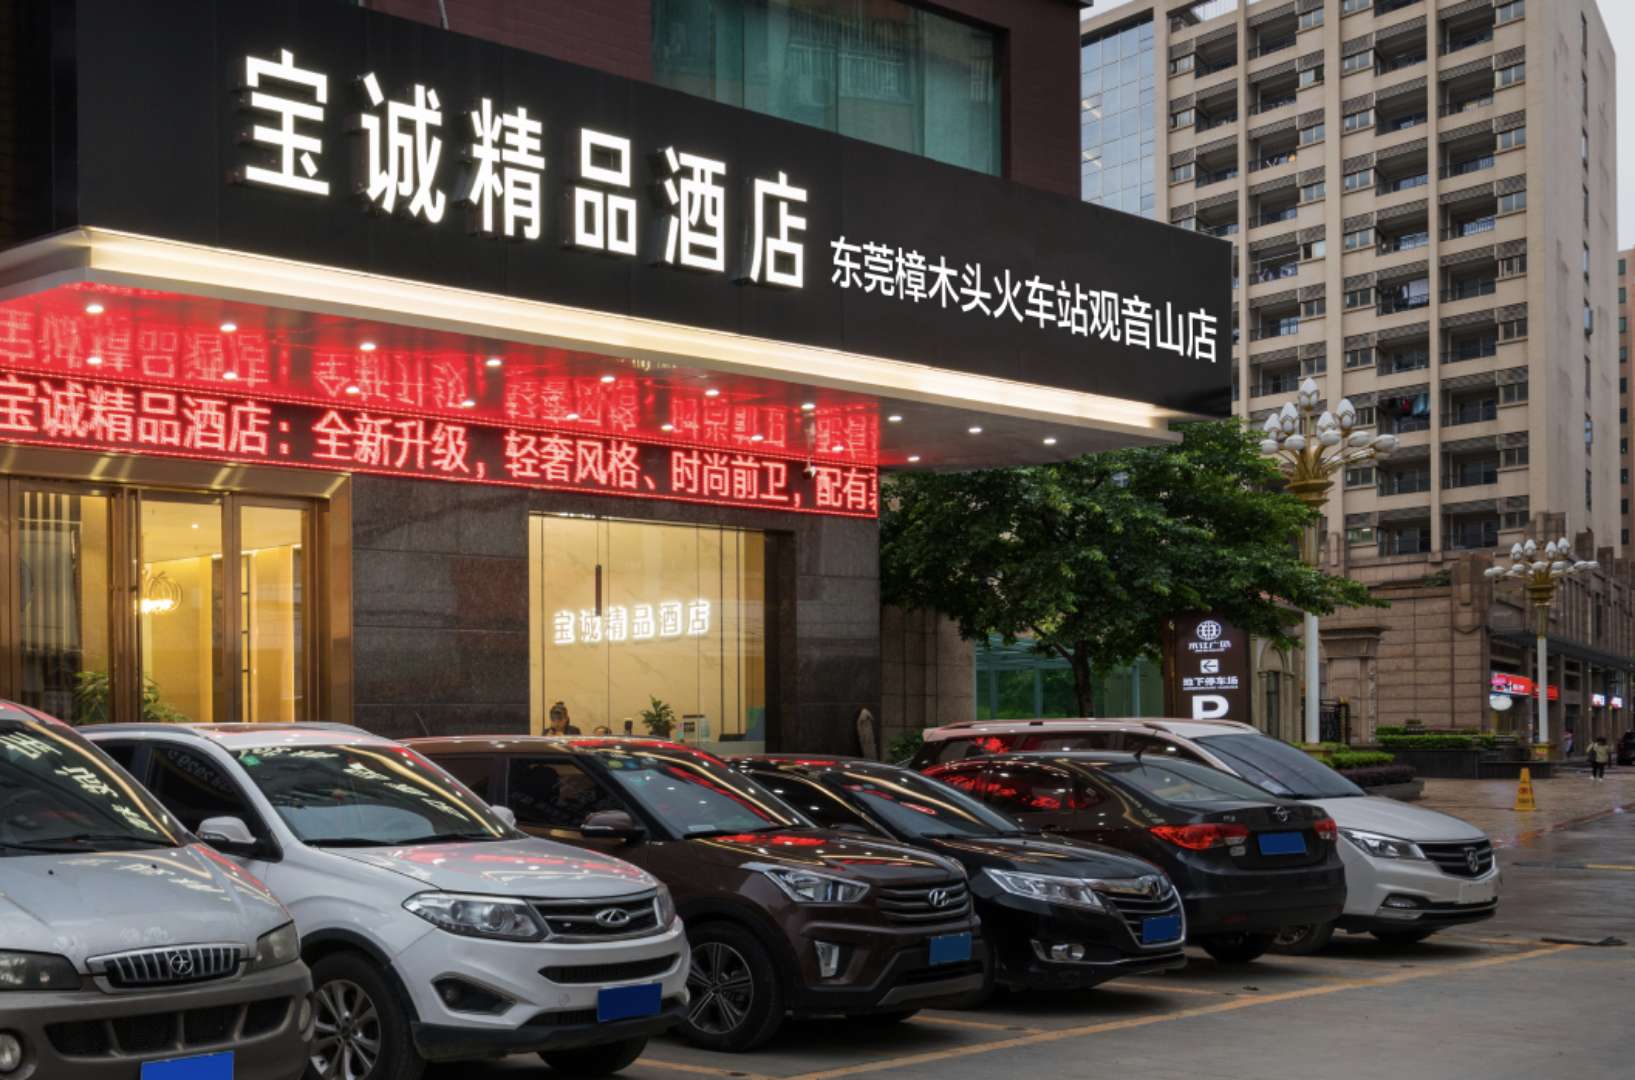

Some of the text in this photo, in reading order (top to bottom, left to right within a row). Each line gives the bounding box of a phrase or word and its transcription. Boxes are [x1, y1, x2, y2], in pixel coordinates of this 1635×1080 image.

[245, 49, 808, 288] 宝诚精品酒店
[830, 236, 1217, 362] 东莞樟木头火车站观音山店
[0, 374, 877, 508] 宝诚精品酒店：全新升级，轻奢风格、时尚前卫，配有
[1192, 695, 1229, 720] P
